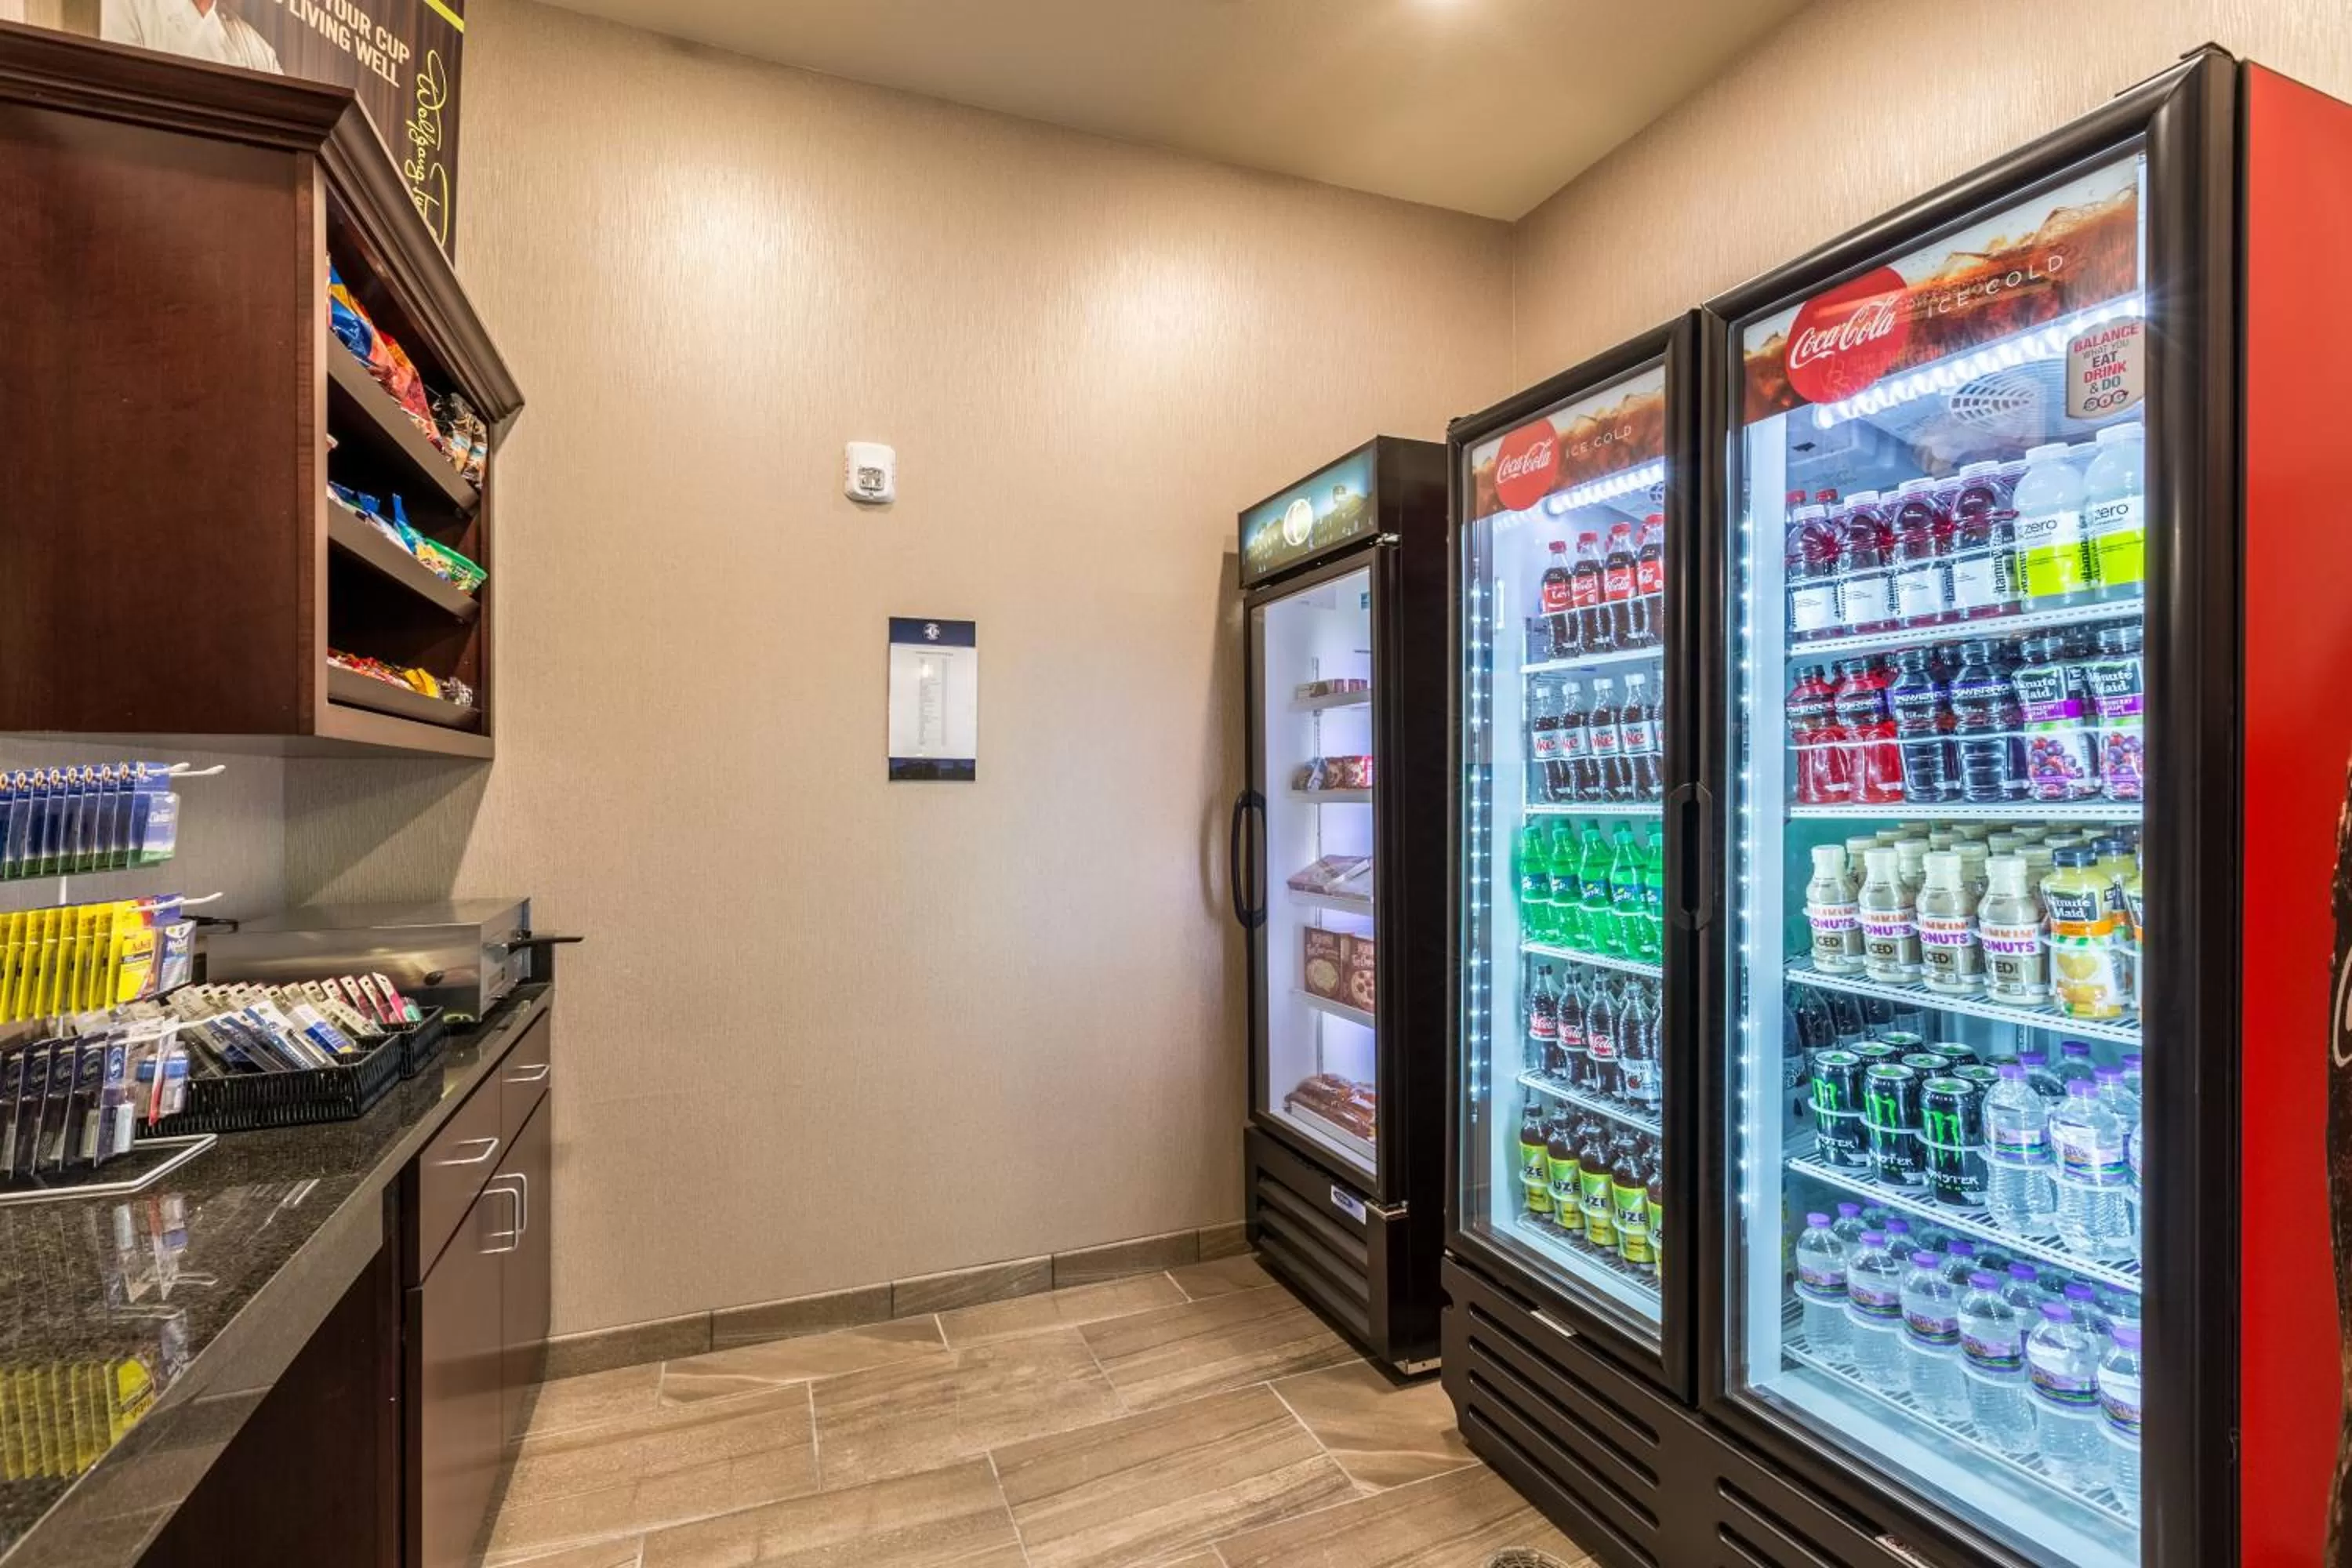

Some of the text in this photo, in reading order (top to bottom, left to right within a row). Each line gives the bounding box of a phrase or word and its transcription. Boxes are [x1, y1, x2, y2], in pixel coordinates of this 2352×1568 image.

[289, 0, 400, 88] LIVING WELL
[376, 26, 410, 64] CUP
[405, 49, 447, 184] Wolfgang
[1928, 255, 2063, 318] ICE COLD
[2074, 322, 2140, 353] BALANCE
[2092, 350, 2118, 368] EAT
[2084, 361, 2126, 383] DRINK
[2089, 376, 2121, 394] & DO
[1566, 426, 1632, 459] ICE COLD
[2095, 504, 2129, 521] zero
[2025, 520, 2057, 534] zero
[2013, 677, 2056, 689] Minute
[2089, 670, 2133, 683] Minute
[1812, 917, 1856, 929] ONUTS
[1866, 924, 1911, 936] ONUTS
[1921, 931, 1968, 945] ONUTS
[1984, 941, 2035, 953] ONUTS
[1553, 1179, 1581, 1192] UZE
[1584, 1194, 1607, 1208] UZE
[1618, 1208, 1647, 1222] UZE
